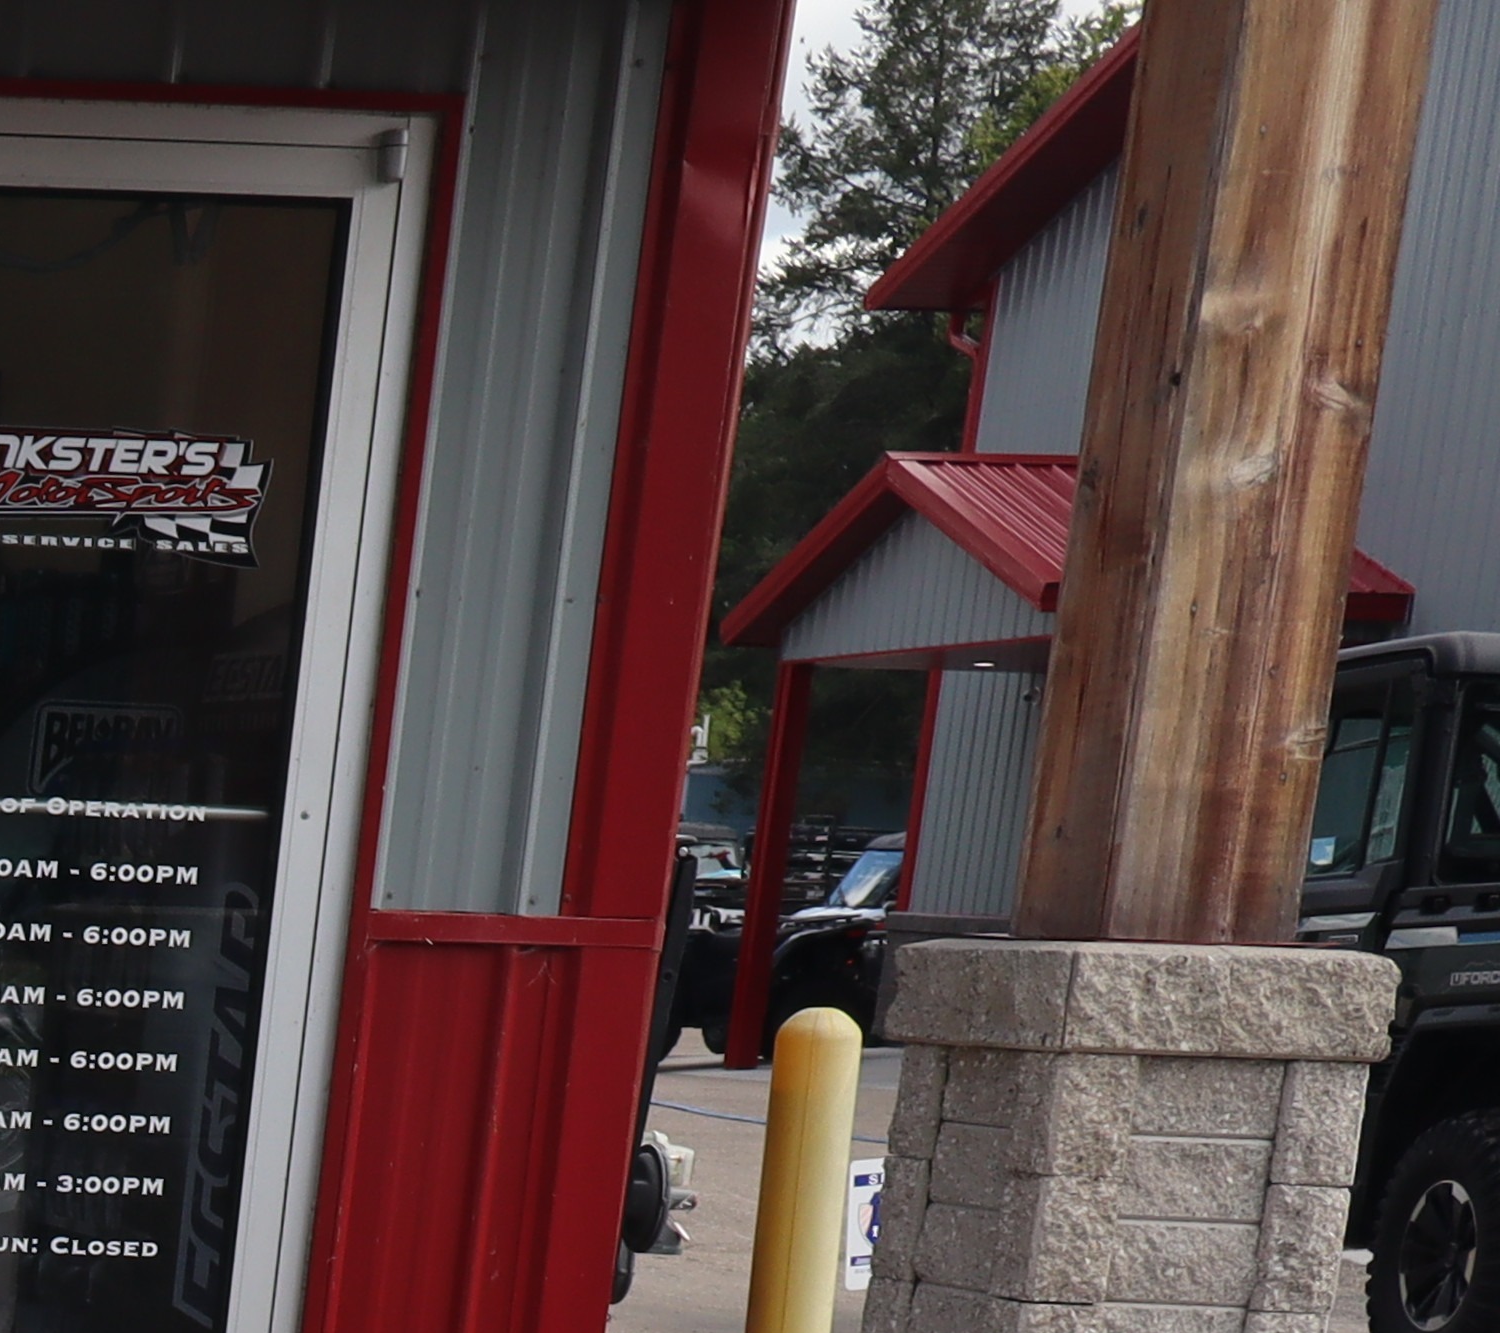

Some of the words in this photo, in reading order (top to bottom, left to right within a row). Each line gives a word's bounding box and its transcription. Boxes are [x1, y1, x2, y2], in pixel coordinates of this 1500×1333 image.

[1, 534, 136, 552] SERVICE
[156, 538, 250, 555] SALES
[1, 797, 36, 814] OF
[47, 797, 206, 822] OPERATION
[90, 862, 198, 886] 6:00PM
[82, 925, 191, 949] 6:00PM
[76, 988, 184, 1010] 6:00PM
[69, 1050, 178, 1073] 6:00PM
[63, 1113, 171, 1135] 6:00PM
[56, 1174, 164, 1196] 3:00PM
[49, 1236, 158, 1258] CLOSED
